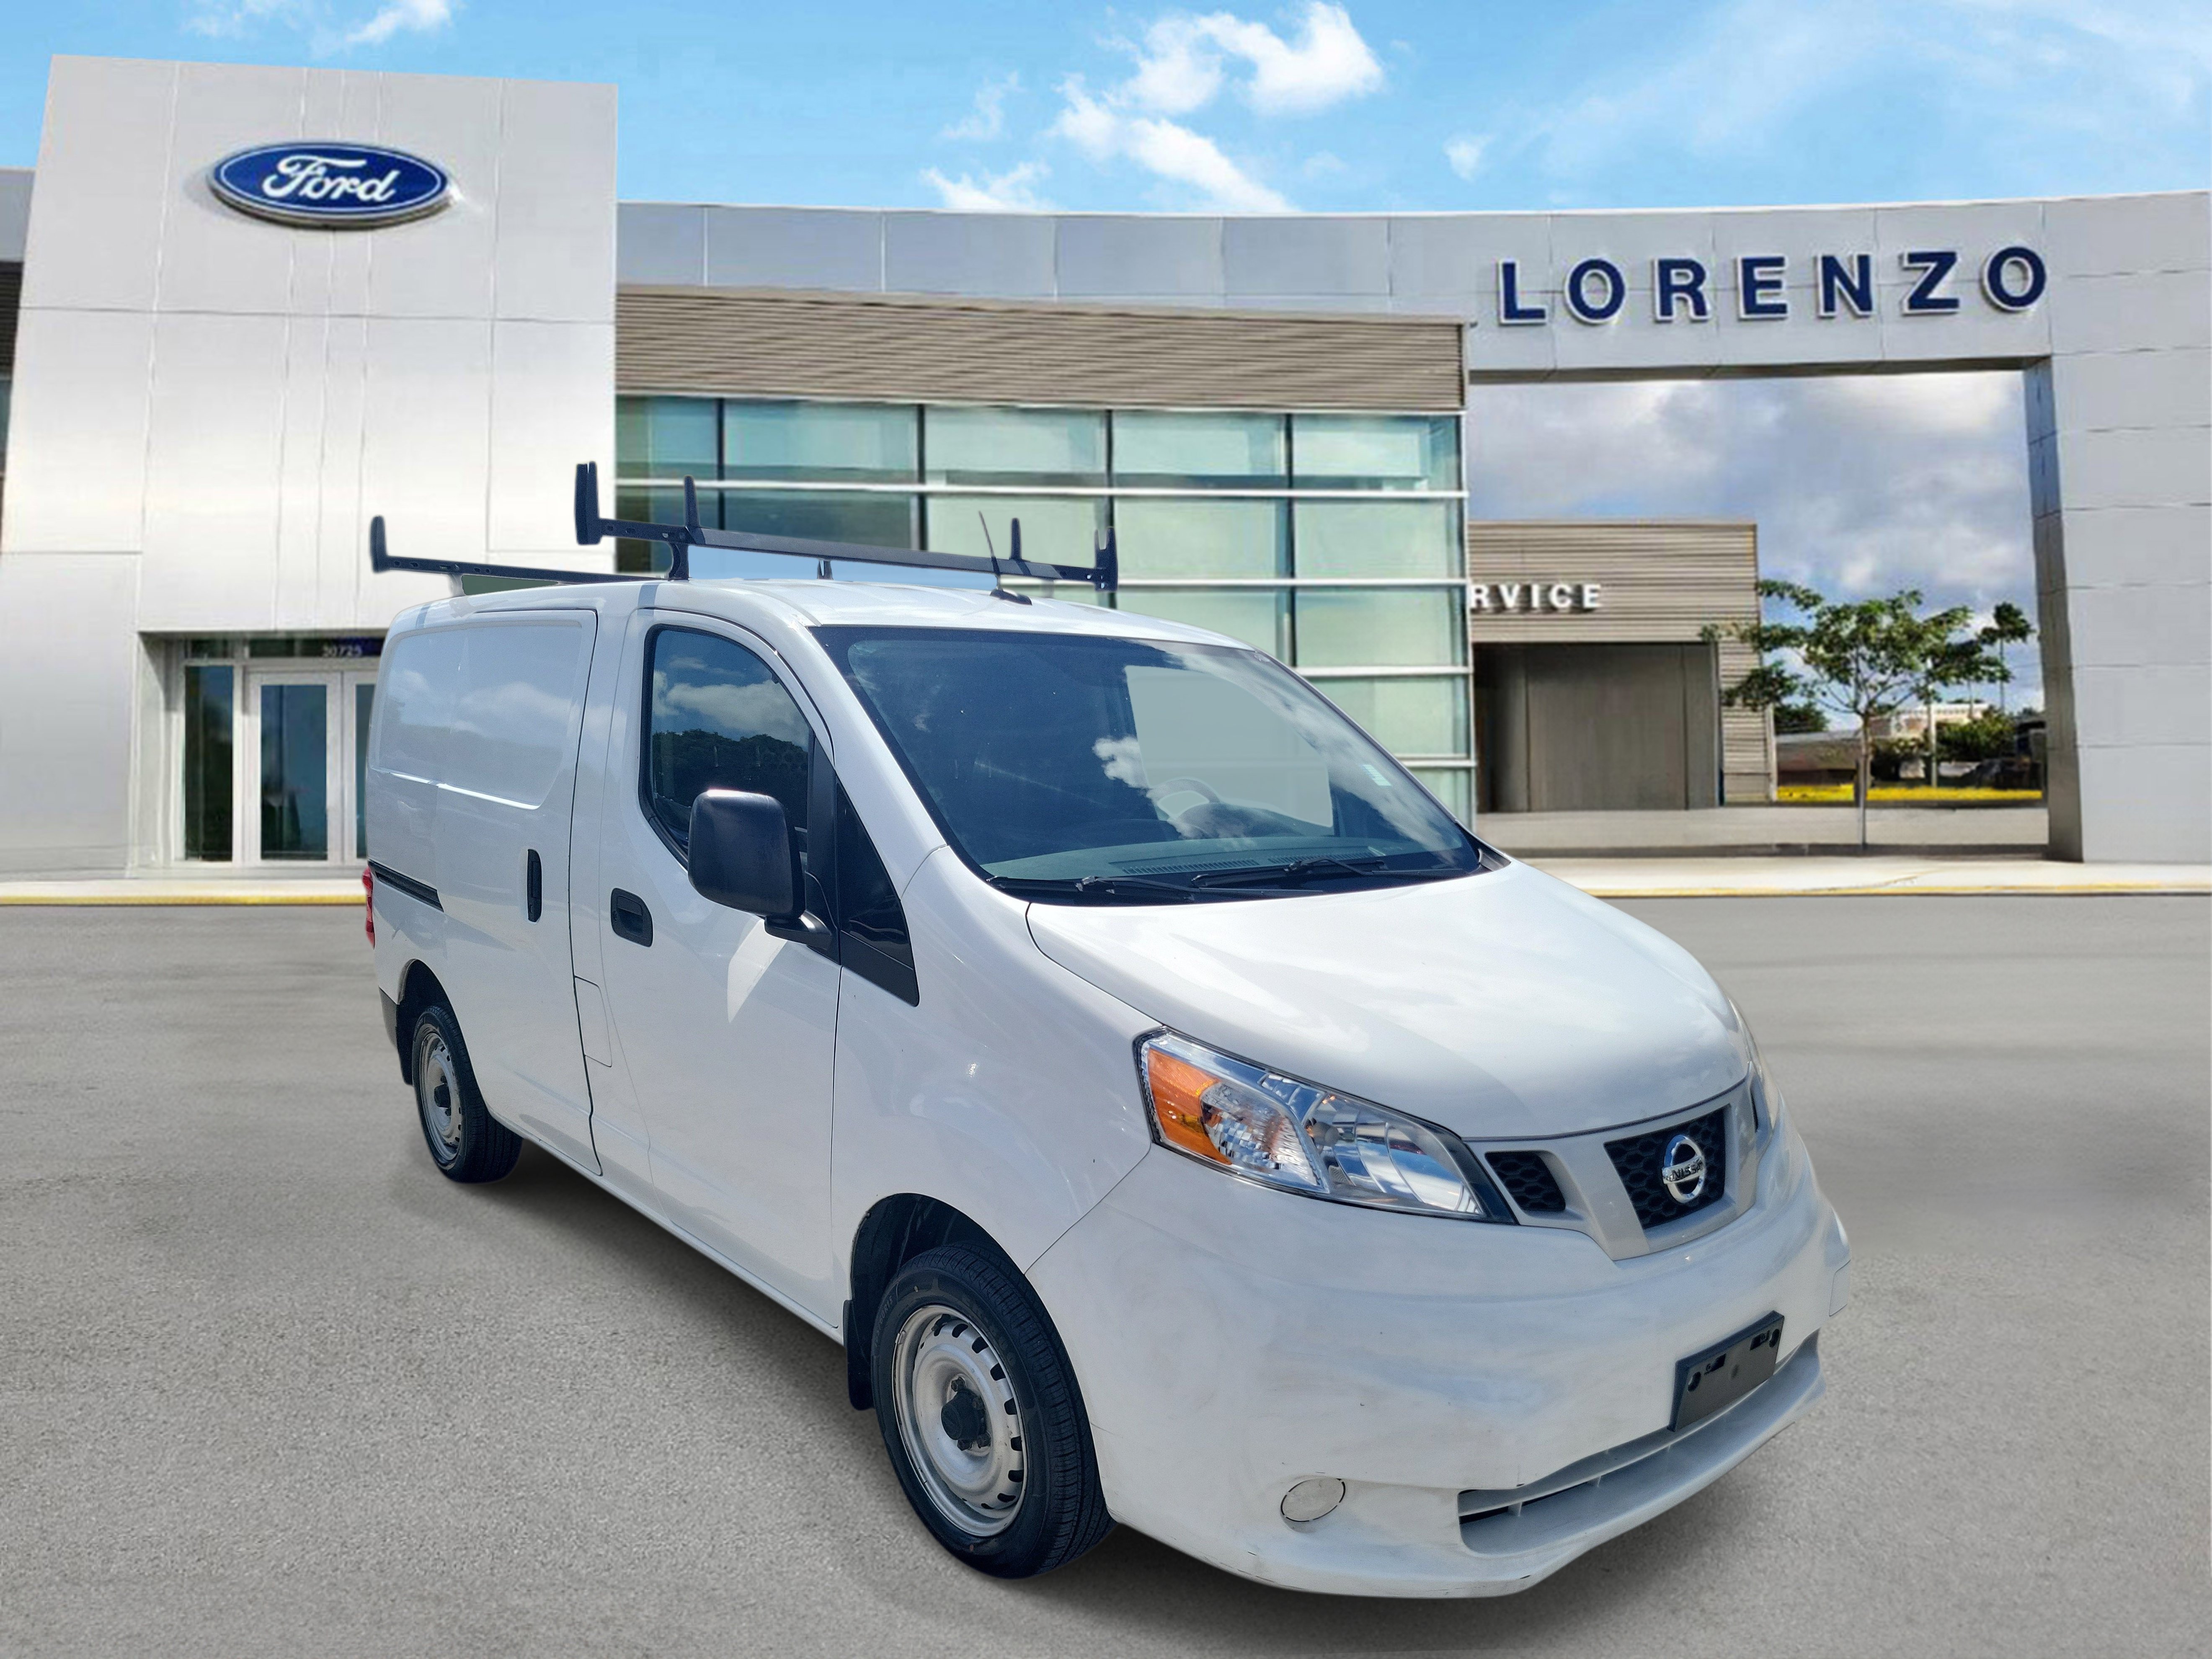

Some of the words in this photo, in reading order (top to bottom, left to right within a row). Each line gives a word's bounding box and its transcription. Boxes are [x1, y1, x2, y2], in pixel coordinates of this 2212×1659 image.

[262, 155, 400, 202] Ford
[1497, 245, 2047, 325] LORENZO
[1670, 1159, 1704, 1181] NISSA
